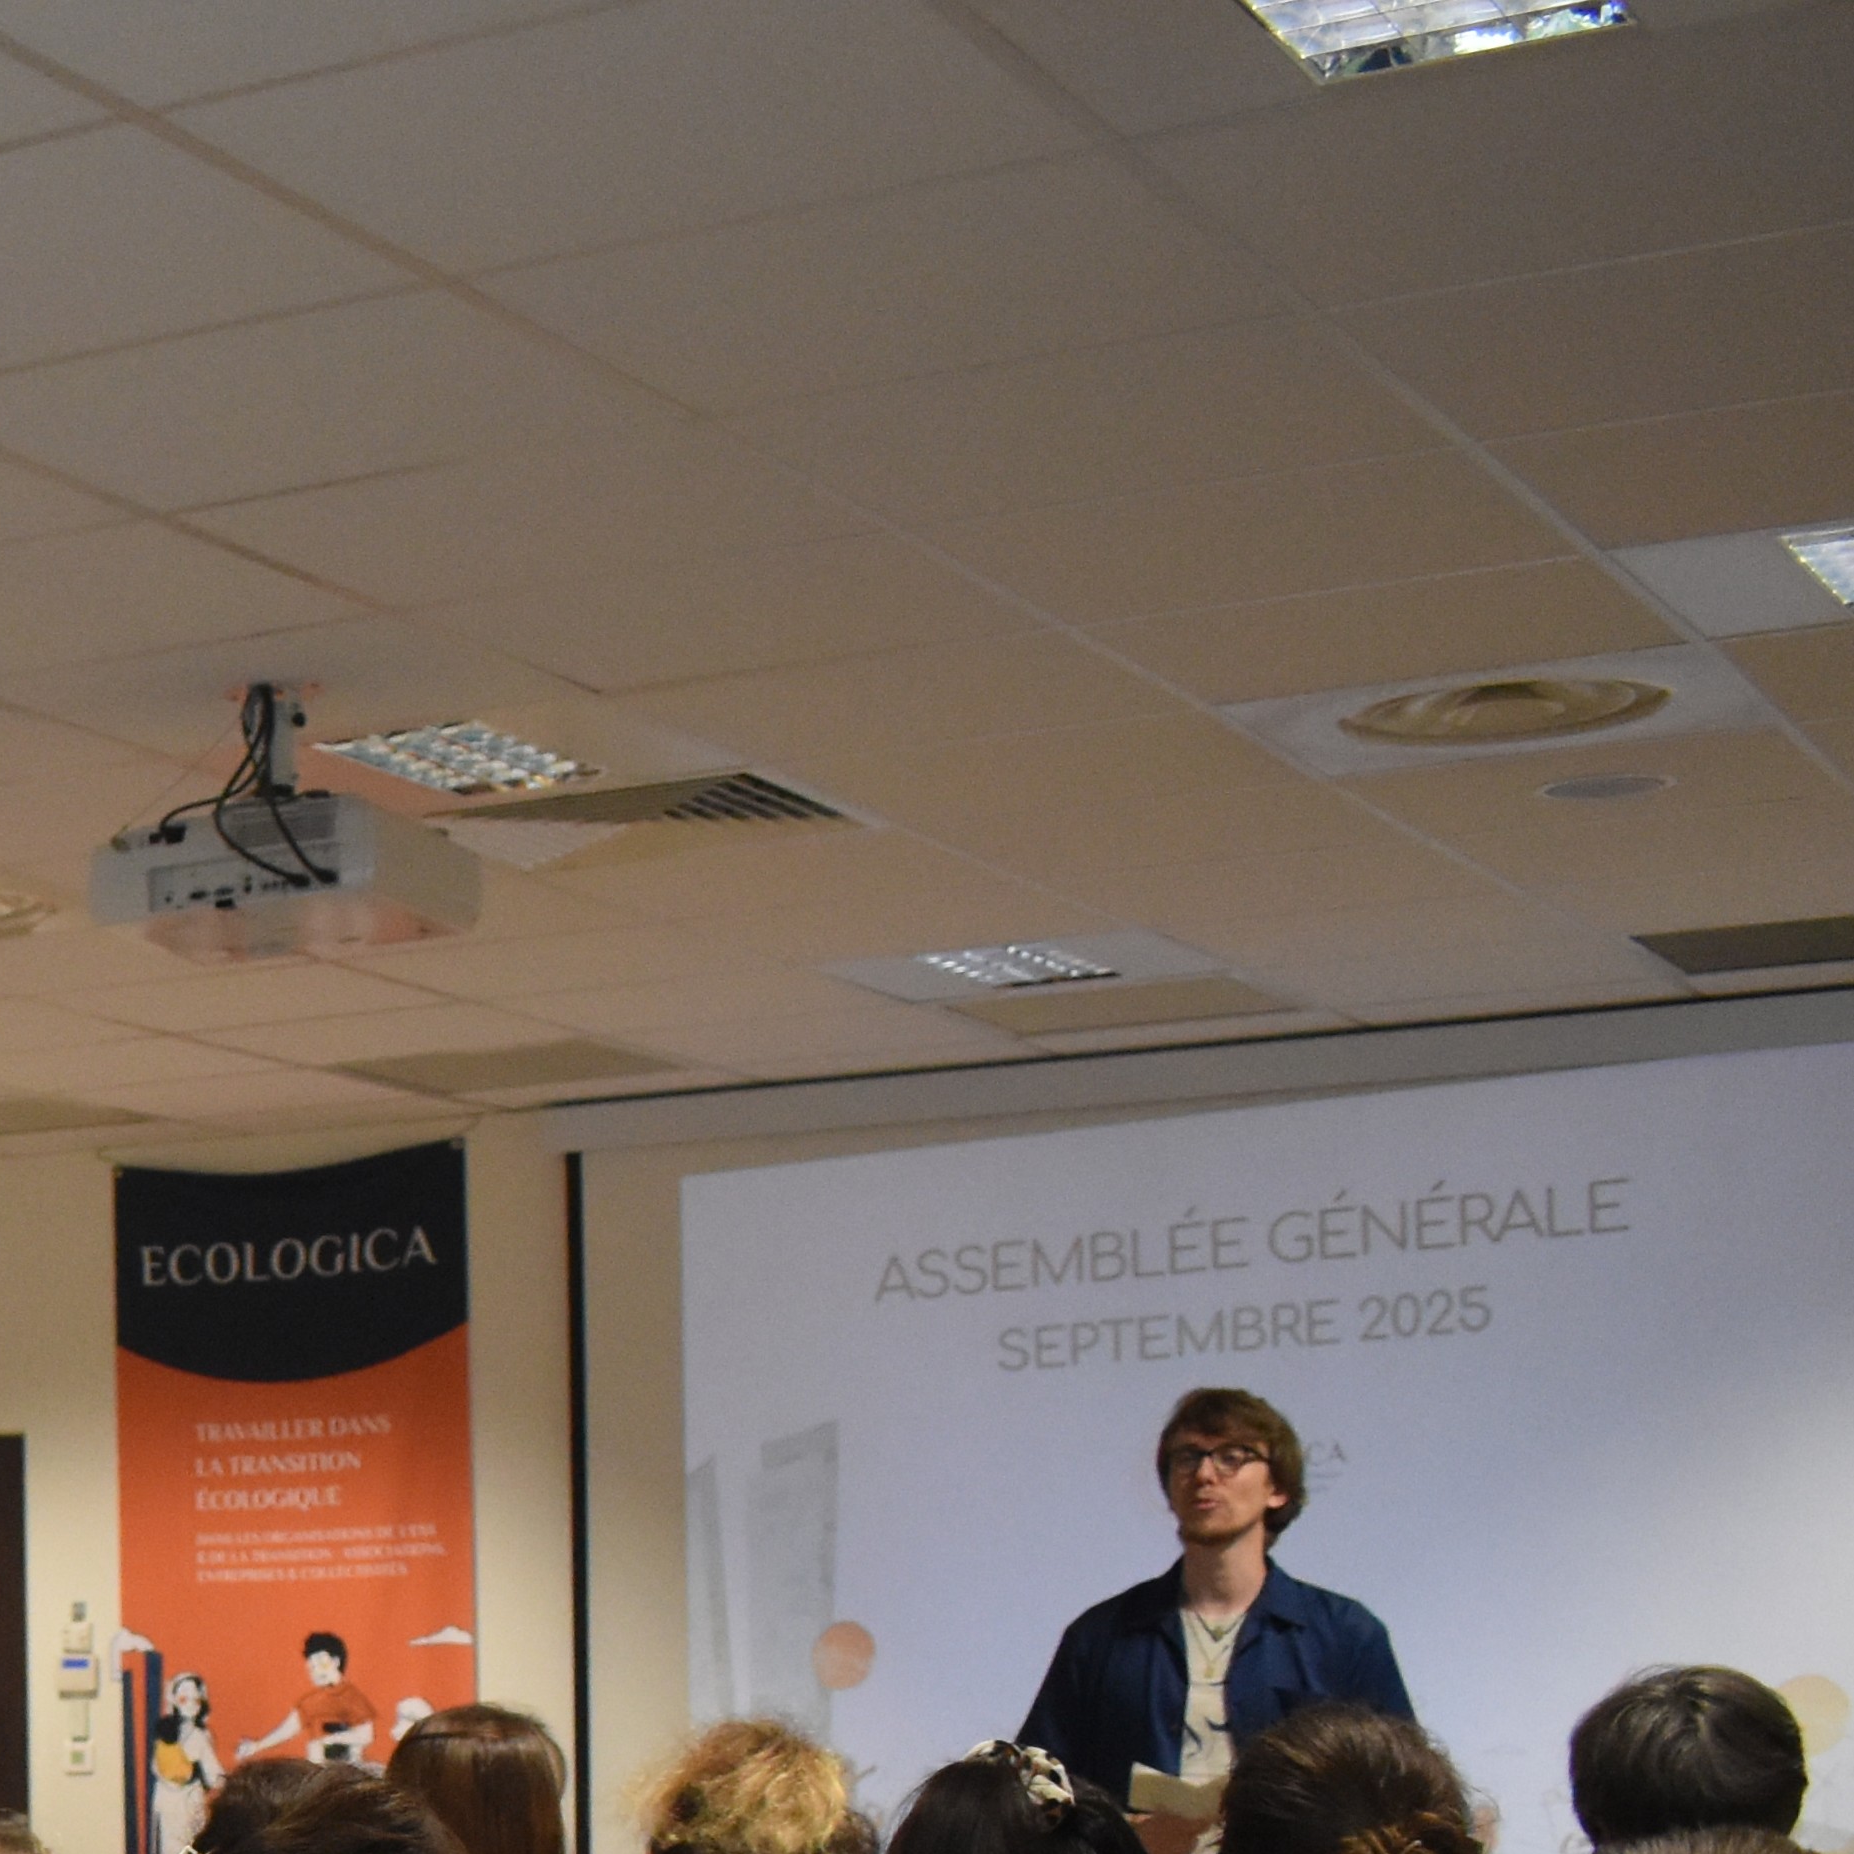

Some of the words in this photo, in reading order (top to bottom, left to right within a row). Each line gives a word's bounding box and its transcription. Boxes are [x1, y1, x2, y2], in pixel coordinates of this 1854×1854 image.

[140, 1225, 438, 1287] ECOLOGICA
[874, 1204, 1250, 1302] ASSEMBLÉE
[1267, 1177, 1632, 1264] GÉNÉRALE
[997, 1298, 1341, 1371] SEPTEMBRE
[1358, 1285, 1491, 1343] 2025
[196, 1418, 324, 1443] TRAVAILLER
[329, 1414, 391, 1438] DANS
[196, 1456, 225, 1477] LA
[229, 1451, 362, 1476] TRANSITION
